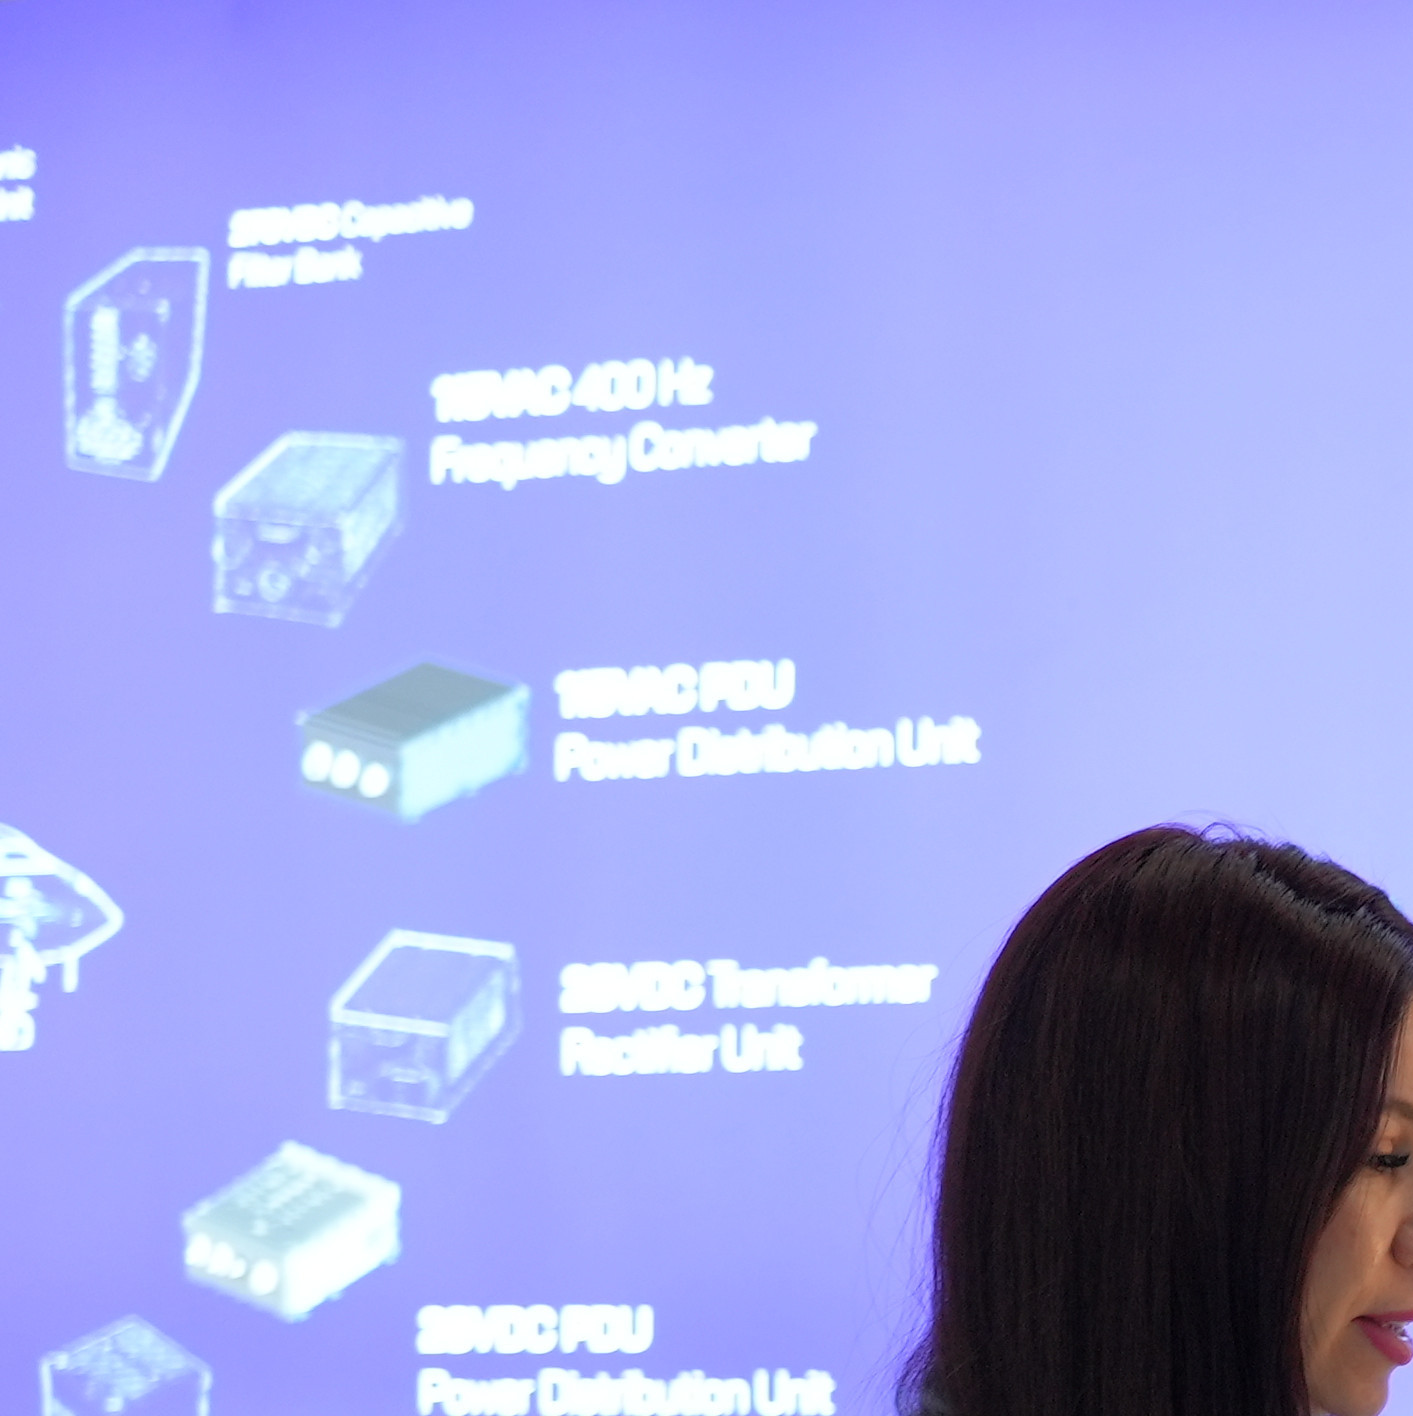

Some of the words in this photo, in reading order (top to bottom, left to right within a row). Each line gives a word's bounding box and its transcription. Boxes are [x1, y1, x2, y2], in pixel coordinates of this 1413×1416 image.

[572, 358, 657, 412] 400
[659, 355, 714, 407] Hz
[429, 434, 627, 491] Frequency
[629, 416, 818, 473] Converter
[554, 731, 675, 782] Power
[676, 721, 894, 777] Distribution
[896, 715, 982, 767] Unit
[707, 956, 938, 1009] Transformer
[558, 1024, 719, 1076] Rectifier
[720, 1022, 804, 1073] Unit
[559, 1303, 655, 1354] PDU
[417, 1367, 537, 1416] Power
[538, 1367, 751, 1416] Distribution
